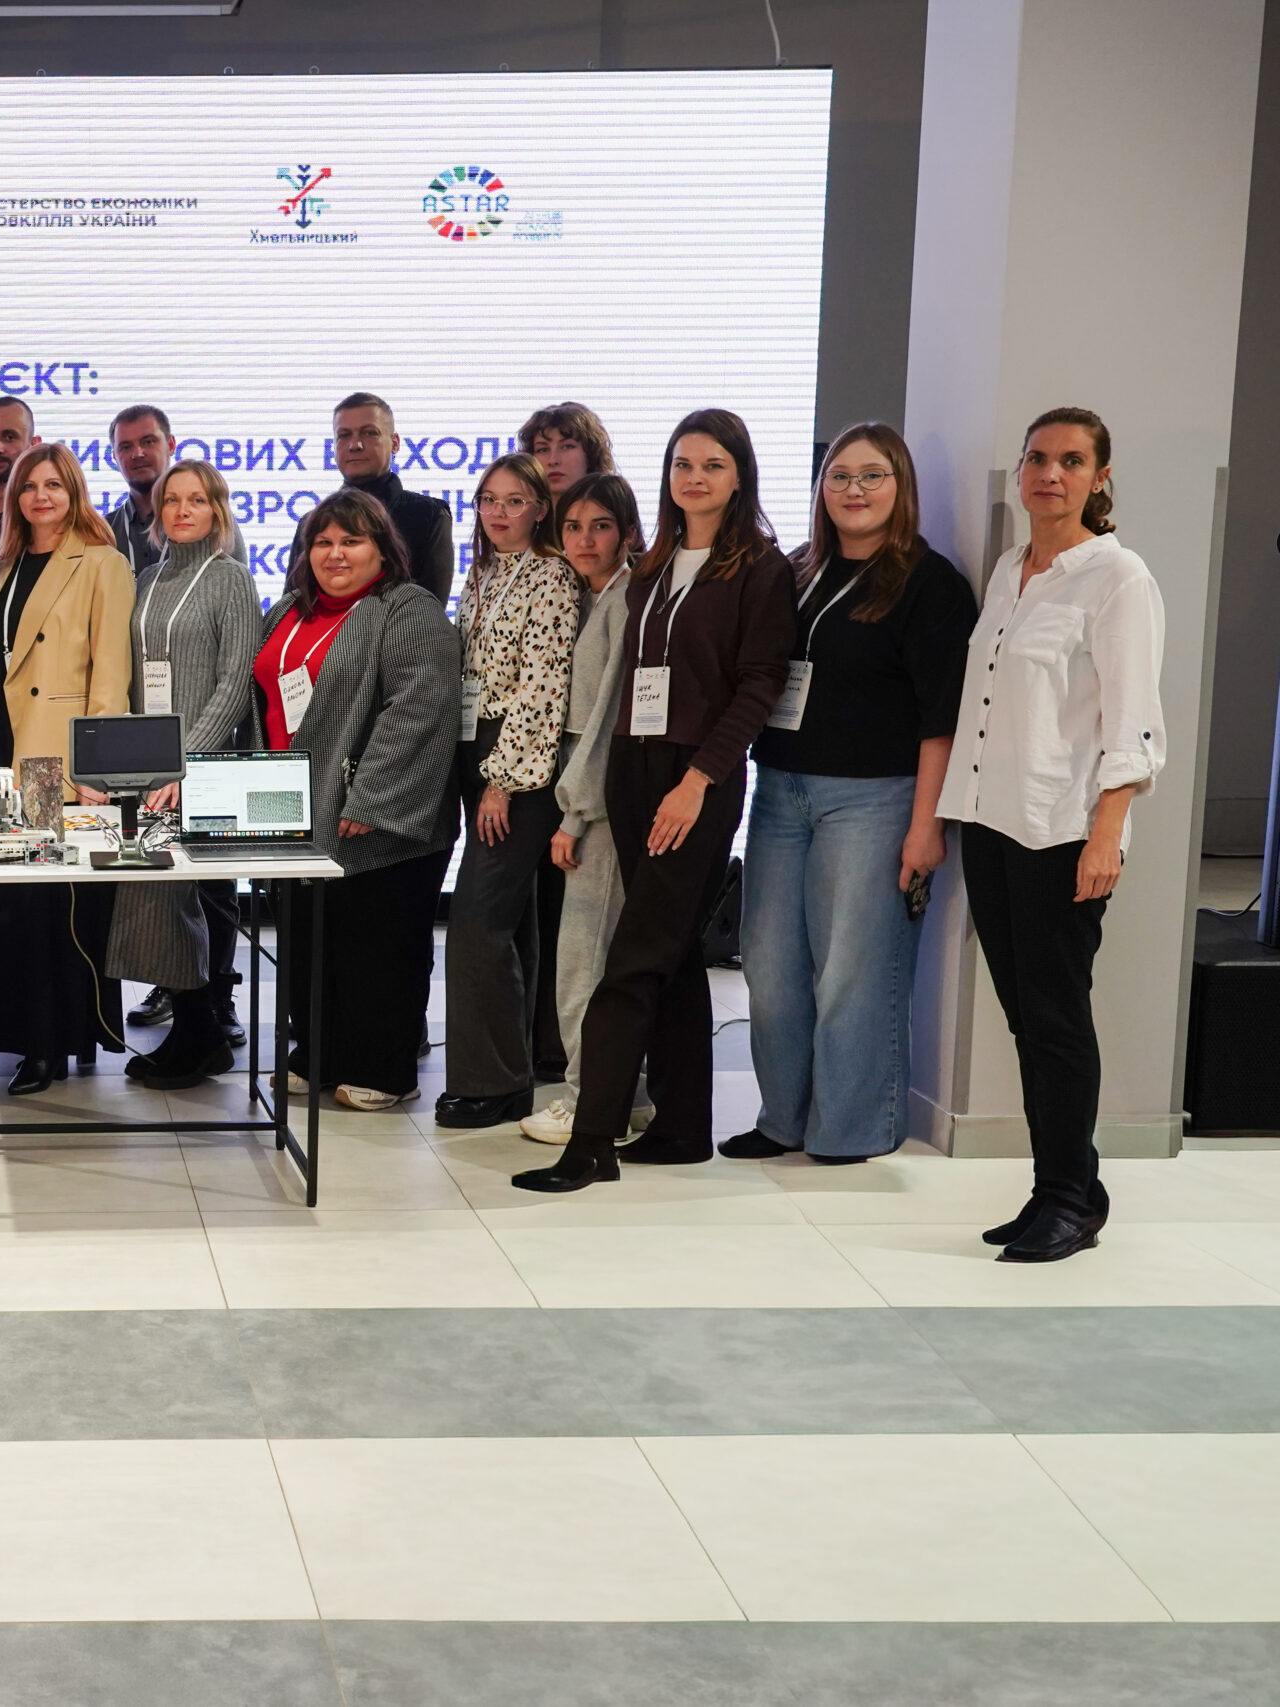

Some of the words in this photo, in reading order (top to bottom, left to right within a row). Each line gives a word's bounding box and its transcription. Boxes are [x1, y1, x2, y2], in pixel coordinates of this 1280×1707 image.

[91, 198, 198, 209] ЕКОНОМІКИ
[422, 194, 510, 212] ASTAR
[79, 212, 157, 227] УКРАЇНИ
